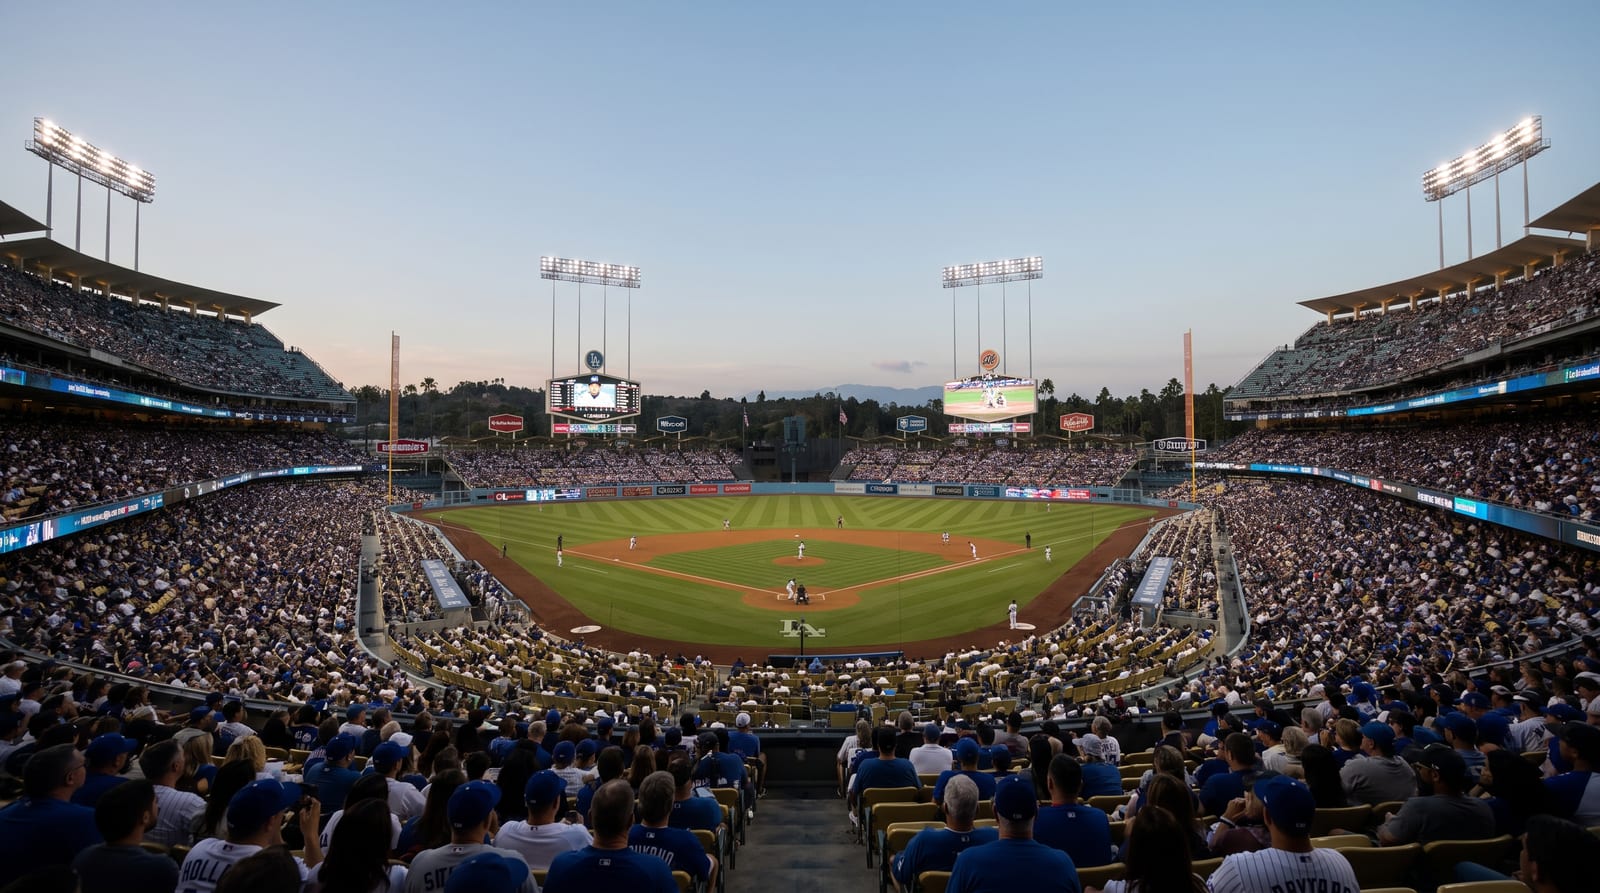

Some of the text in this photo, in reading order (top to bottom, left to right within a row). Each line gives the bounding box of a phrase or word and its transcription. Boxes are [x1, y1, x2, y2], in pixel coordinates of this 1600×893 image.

[590, 353, 600, 367] LA
[779, 619, 826, 638] LA
[182, 859, 231, 883] HOLL
[424, 867, 455, 891] SIT
